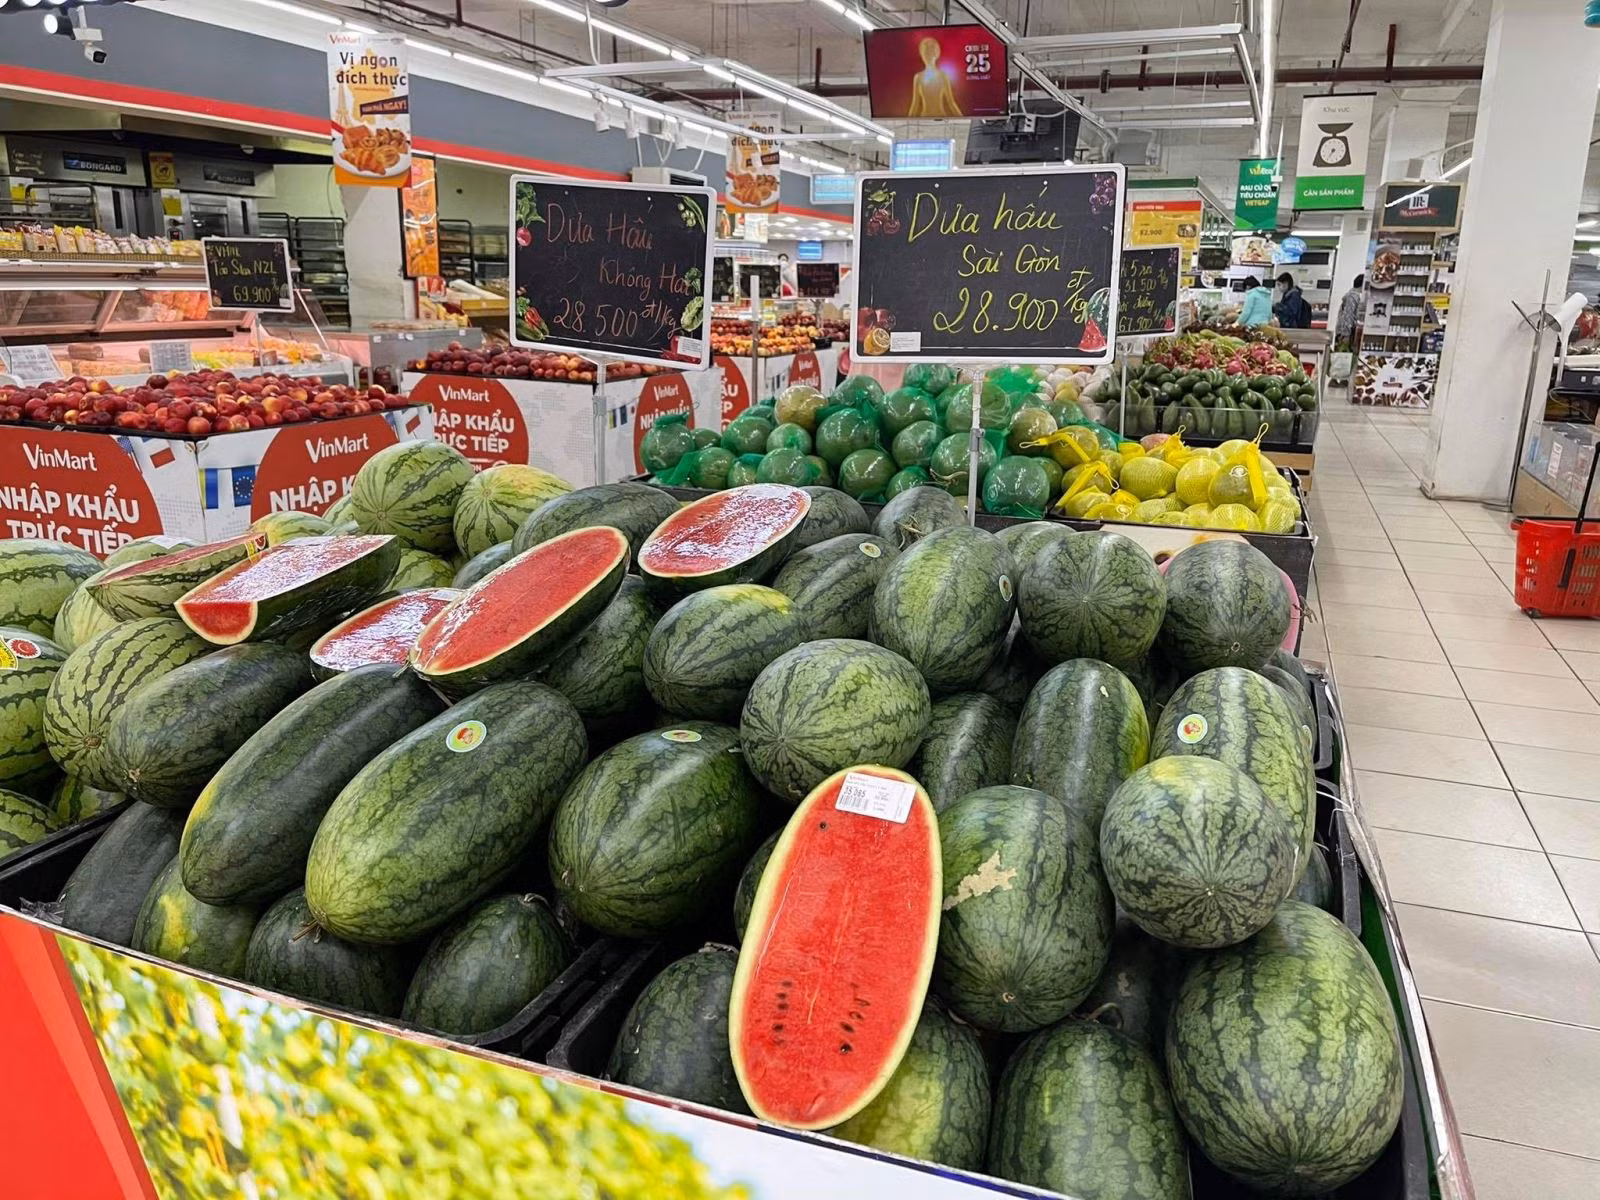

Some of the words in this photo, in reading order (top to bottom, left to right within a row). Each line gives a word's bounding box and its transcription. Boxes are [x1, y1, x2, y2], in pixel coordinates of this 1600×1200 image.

[340, 52, 355, 69] Vị
[361, 55, 397, 69] ngon
[965, 53, 991, 73] 25
[336, 70, 368, 85] đích
[373, 72, 407, 90] thực
[80, 161, 122, 172] BONGARD
[908, 191, 980, 243] Dưa
[958, 243, 1004, 277] Sài
[1015, 243, 1061, 274] Gòn
[599, 256, 651, 301] Không
[233, 285, 272, 303] 69.900
[932, 287, 1058, 334] 28.900
[438, 384, 490, 403] VinMart
[653, 384, 680, 401] VinMart
[433, 408, 462, 432] ẬP
[465, 409, 515, 434] KHẨU
[305, 433, 370, 464] VinMart
[470, 431, 510, 454] TIẾP
[22, 442, 98, 471] VinMart
[66, 484, 141, 524] KHẨU
[269, 476, 338, 512] NHẬP
